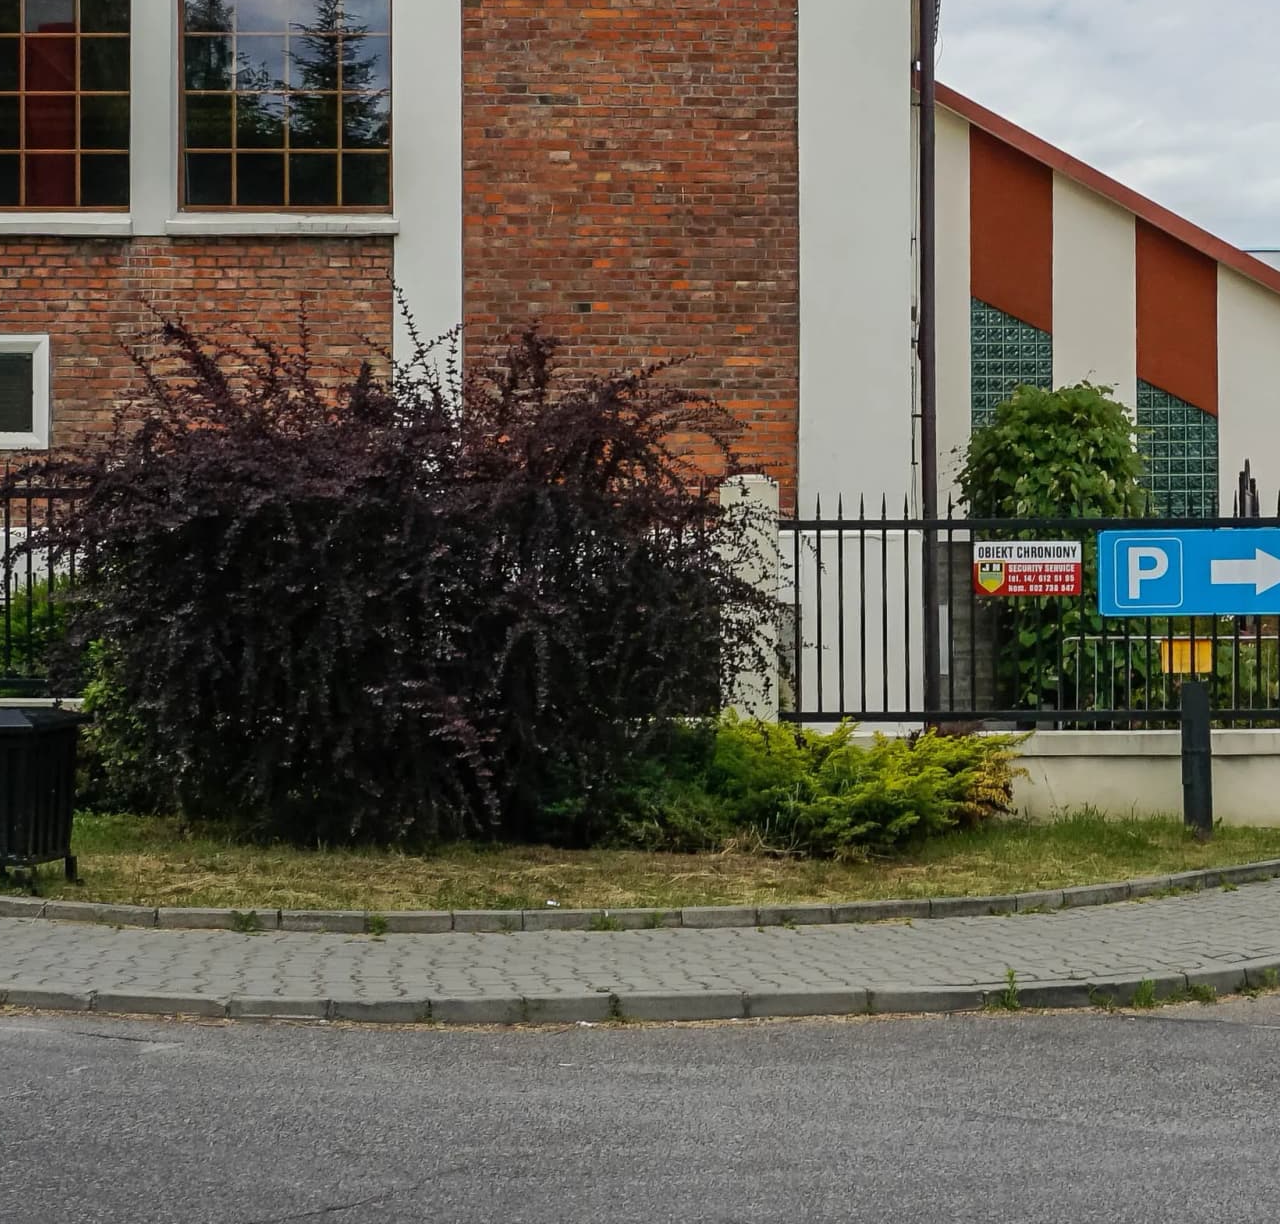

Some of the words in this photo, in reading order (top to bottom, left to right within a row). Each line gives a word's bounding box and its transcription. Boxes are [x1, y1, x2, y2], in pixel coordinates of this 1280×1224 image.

[978, 545, 1014, 559] OBIEKT
[1016, 545, 1077, 559] CHRONIONY
[1128, 546, 1169, 600] P
